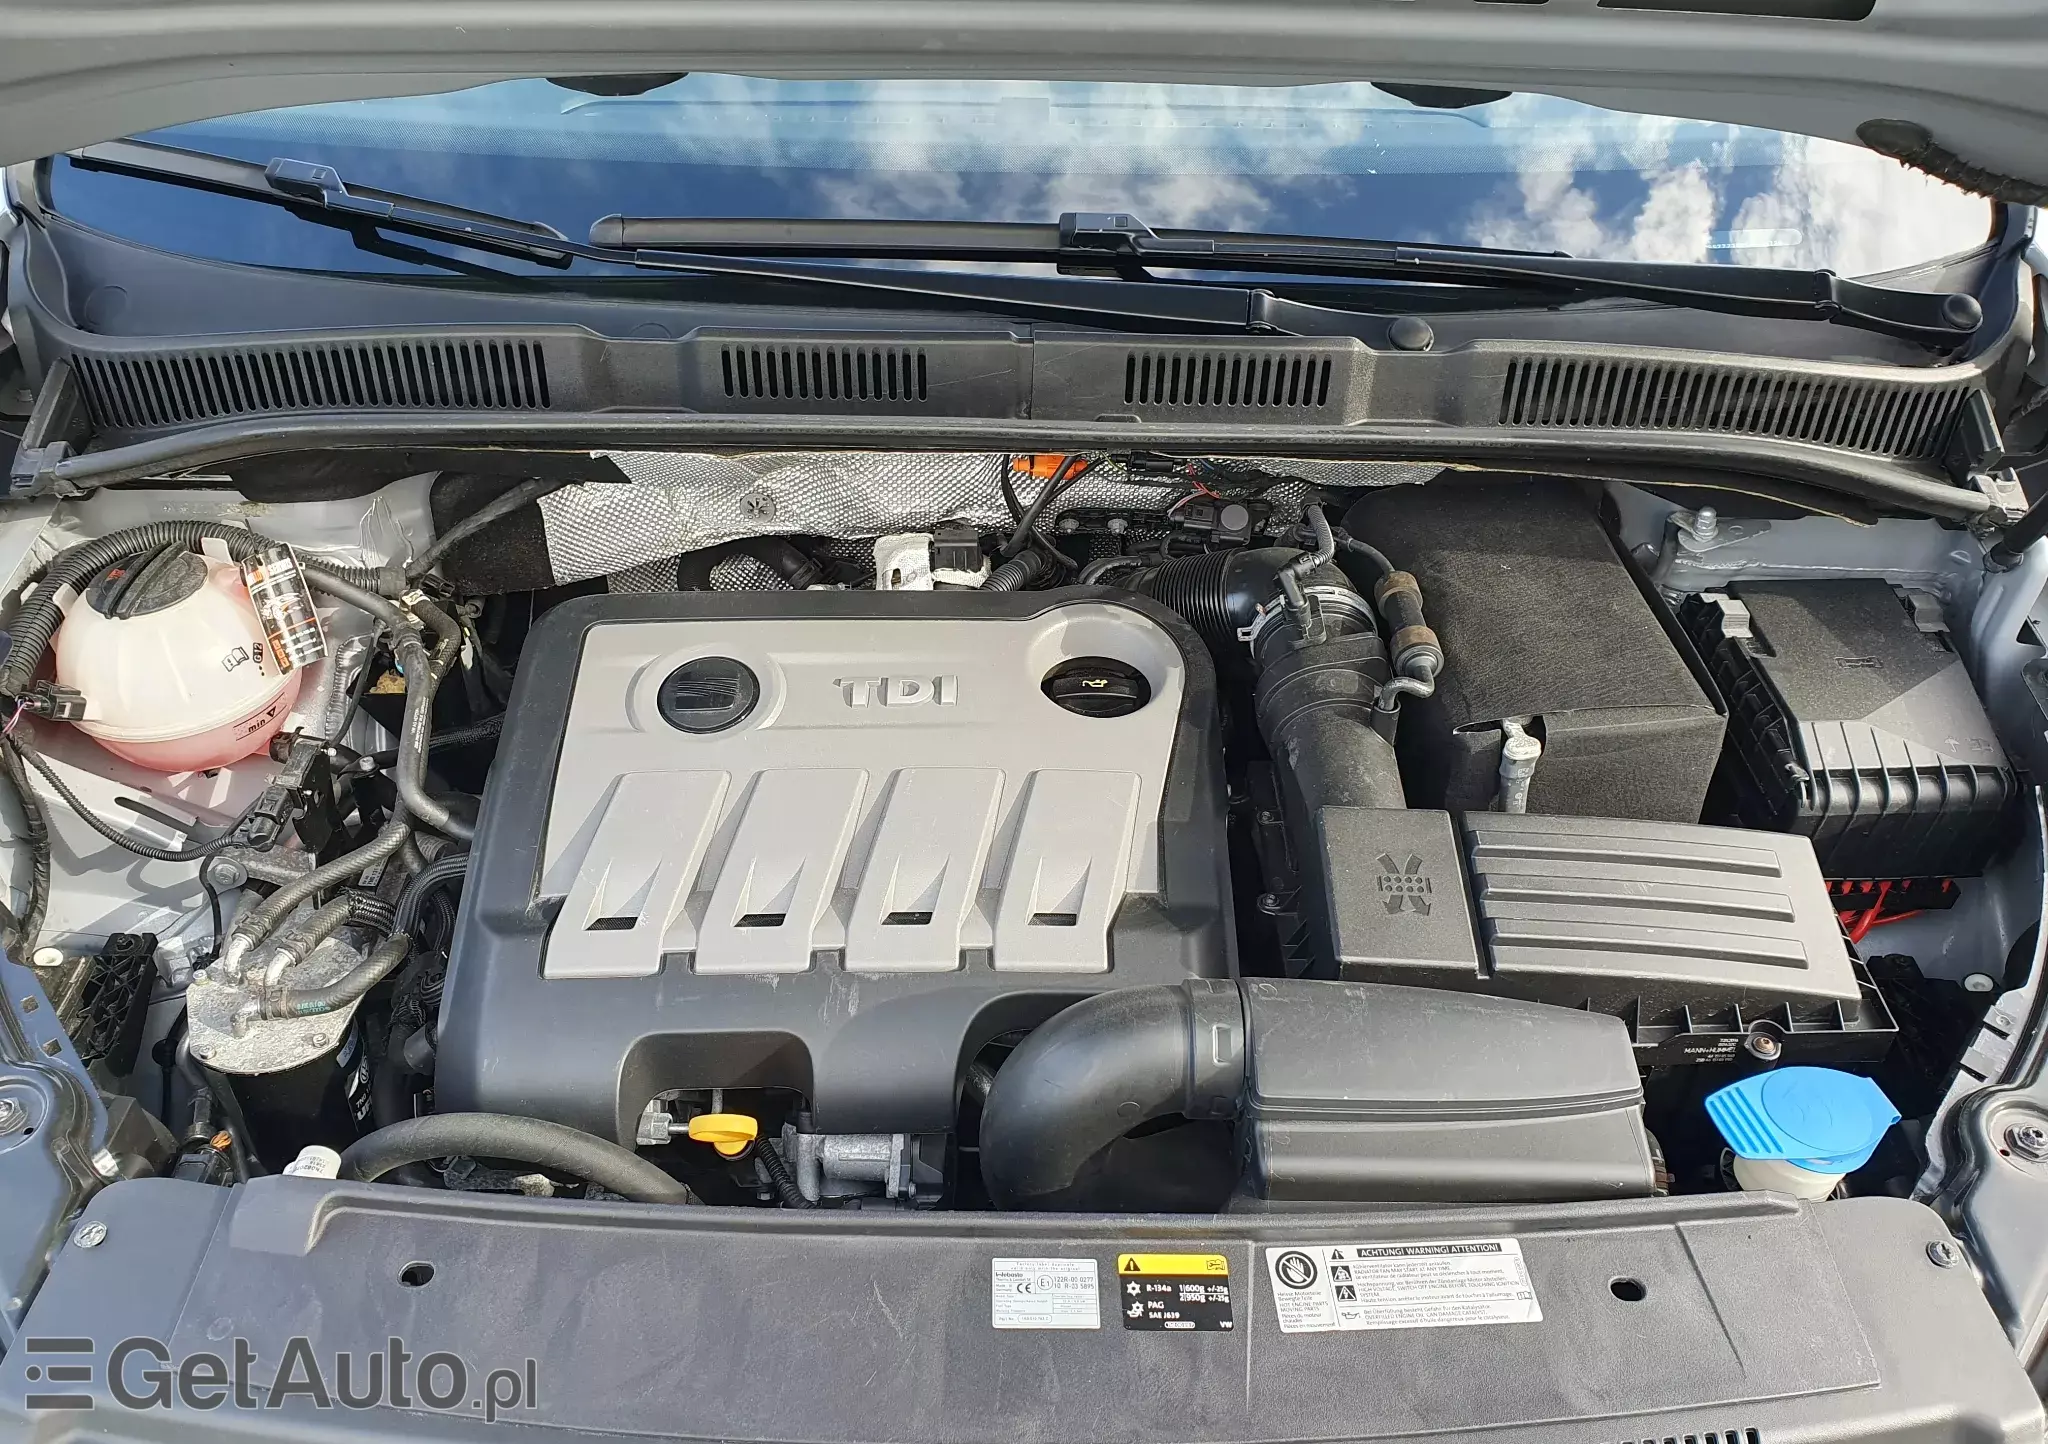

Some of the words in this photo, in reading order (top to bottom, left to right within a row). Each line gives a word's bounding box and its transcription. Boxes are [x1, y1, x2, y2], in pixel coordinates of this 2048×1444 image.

[832, 675, 958, 708] TDI
[248, 719, 265, 732] min
[1360, 1247, 1404, 1256] ACHTUNG!
[1405, 1245, 1449, 1255] WARNING!
[1449, 1243, 1499, 1252] ATTENTION!
[1016, 1283, 1031, 1294] CE
[1146, 1284, 1172, 1292] R-134a
[1185, 1284, 1205, 1294] 600g
[1186, 1294, 1206, 1303] 950g
[1147, 1301, 1165, 1309] PAG
